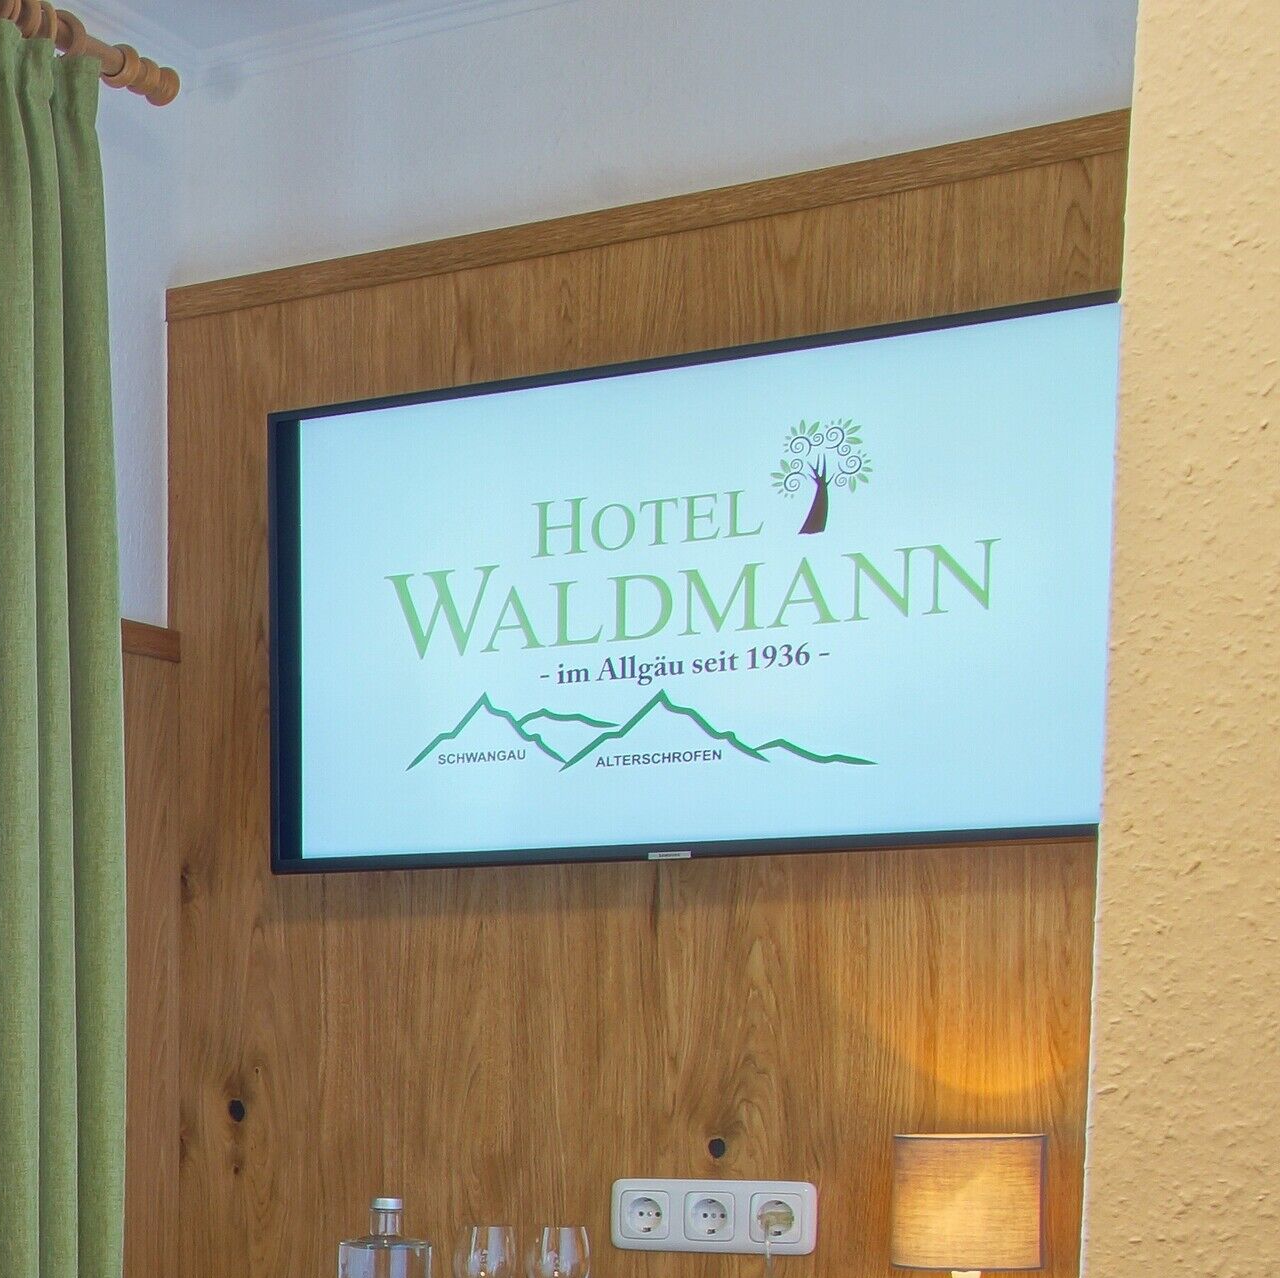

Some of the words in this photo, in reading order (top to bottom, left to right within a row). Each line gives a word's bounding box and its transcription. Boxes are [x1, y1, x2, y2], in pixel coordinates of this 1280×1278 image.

[531, 490, 763, 558] HOTEL
[384, 538, 1001, 660] WALDMANN
[557, 664, 590, 685] im
[595, 652, 683, 687] Allgäu
[692, 647, 742, 674] seit
[747, 642, 810, 670] 1936
[437, 751, 526, 766] SCHWANGAU
[596, 750, 722, 767] ALTERSCHROFEN
